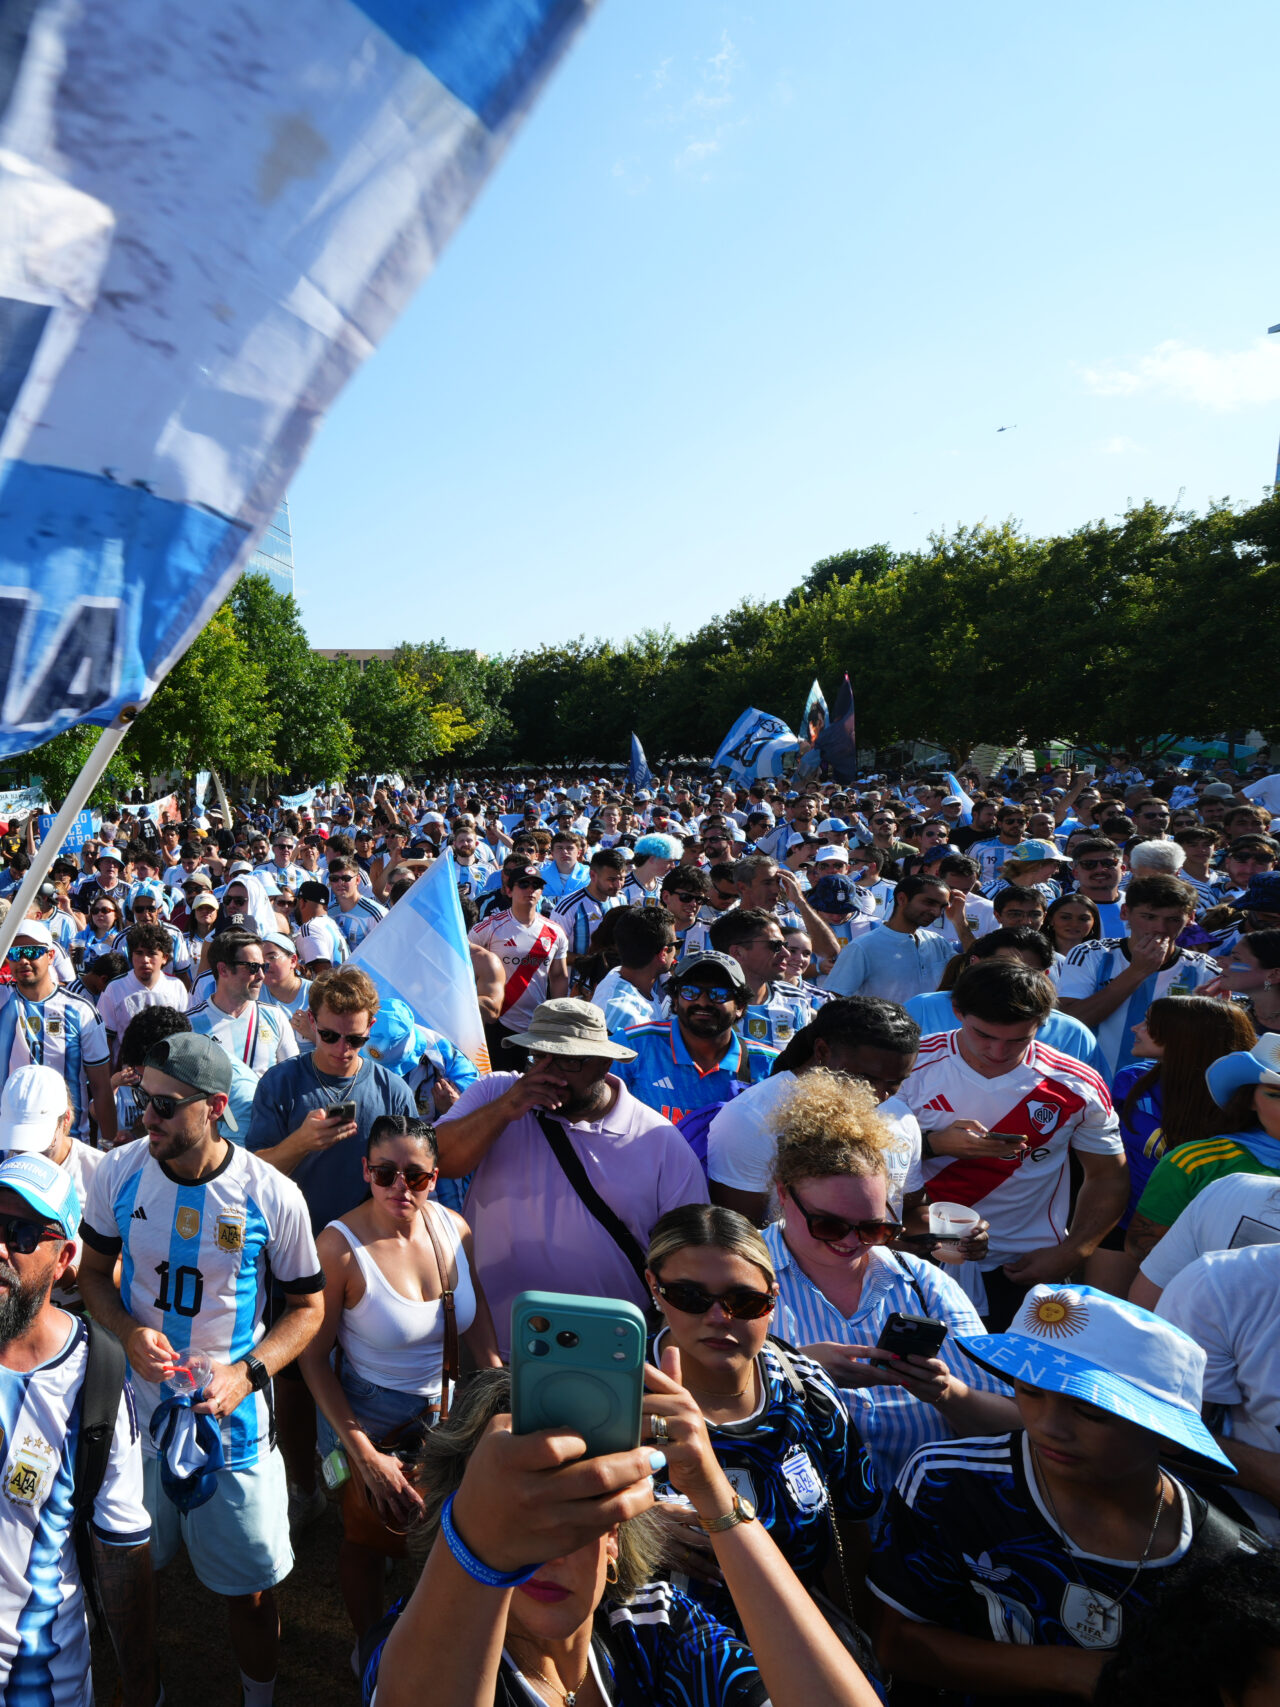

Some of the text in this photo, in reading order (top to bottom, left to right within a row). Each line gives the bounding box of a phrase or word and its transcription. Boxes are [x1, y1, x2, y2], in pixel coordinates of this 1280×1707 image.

[985, 856, 998, 865] 19
[220, 1225, 240, 1245] AFA
[153, 1260, 204, 1318] 10
[969, 1335, 1166, 1433] GENTINA
[10, 1464, 38, 1495] AFA
[793, 1467, 815, 1494] AFA
[1076, 1622, 1103, 1638] FIFA
